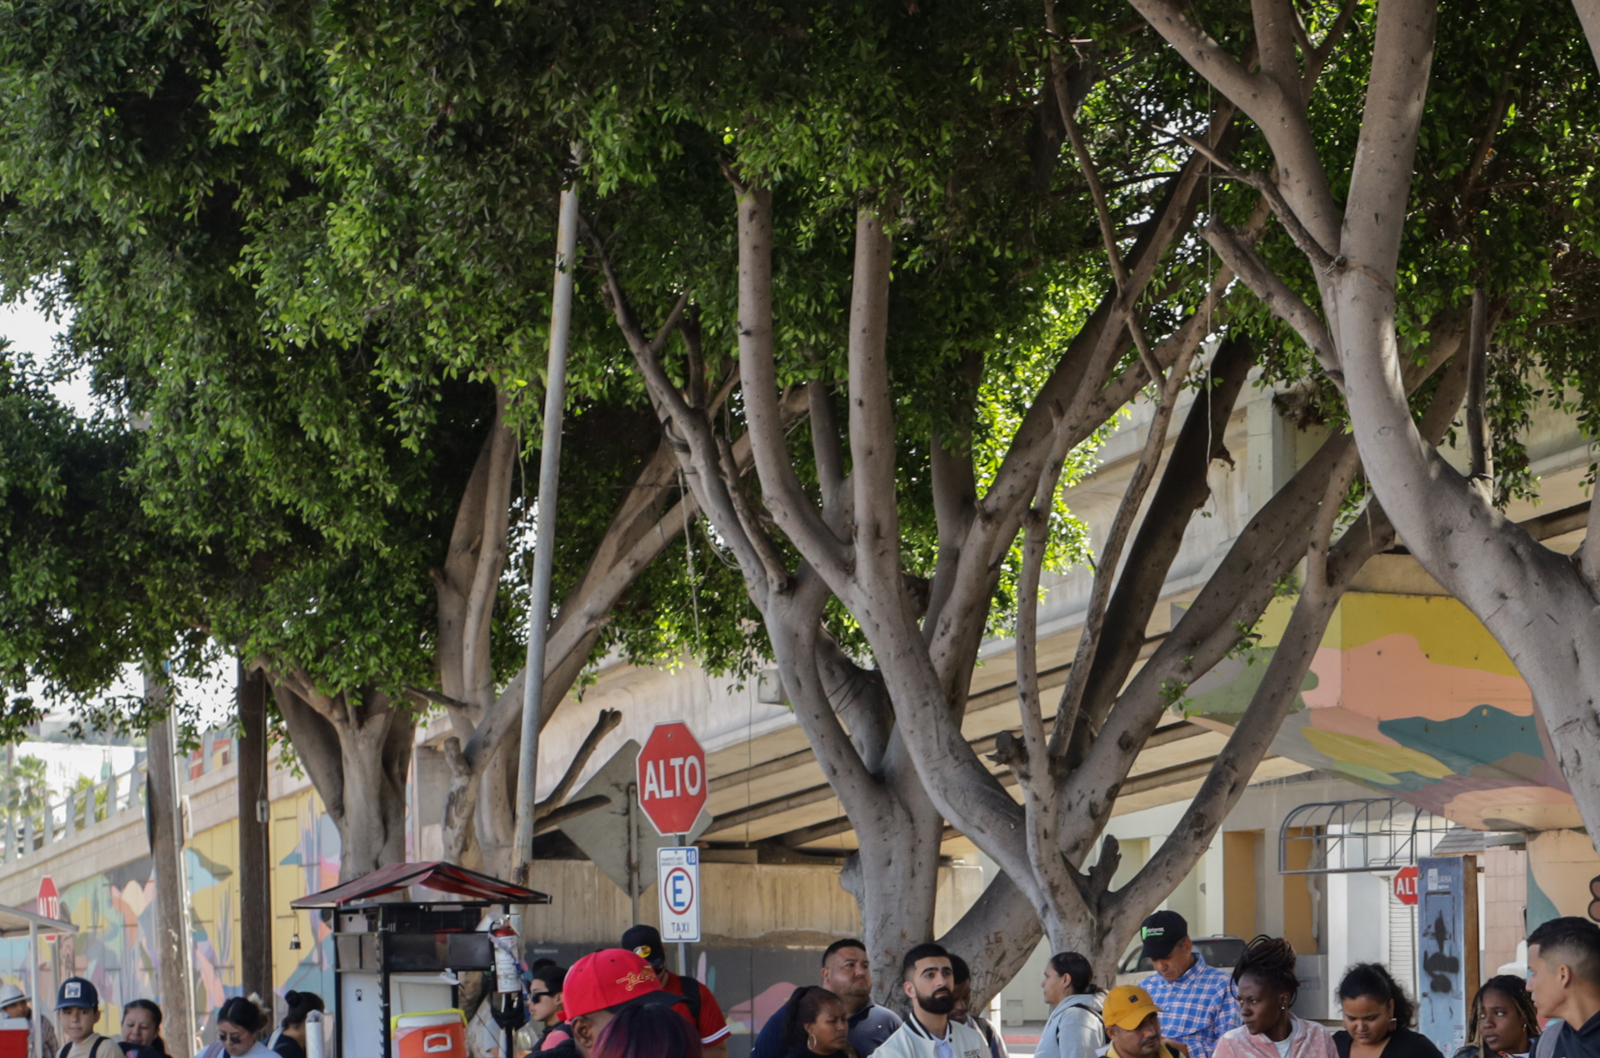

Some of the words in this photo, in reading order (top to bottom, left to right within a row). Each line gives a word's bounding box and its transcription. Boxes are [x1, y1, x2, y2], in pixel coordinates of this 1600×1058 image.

[644, 755, 702, 801] ALTO
[686, 850, 697, 864] 18
[672, 875, 686, 907] E
[1396, 877, 1418, 895] ALT
[39, 896, 59, 920] ALTO
[671, 921, 690, 934] TAXI
